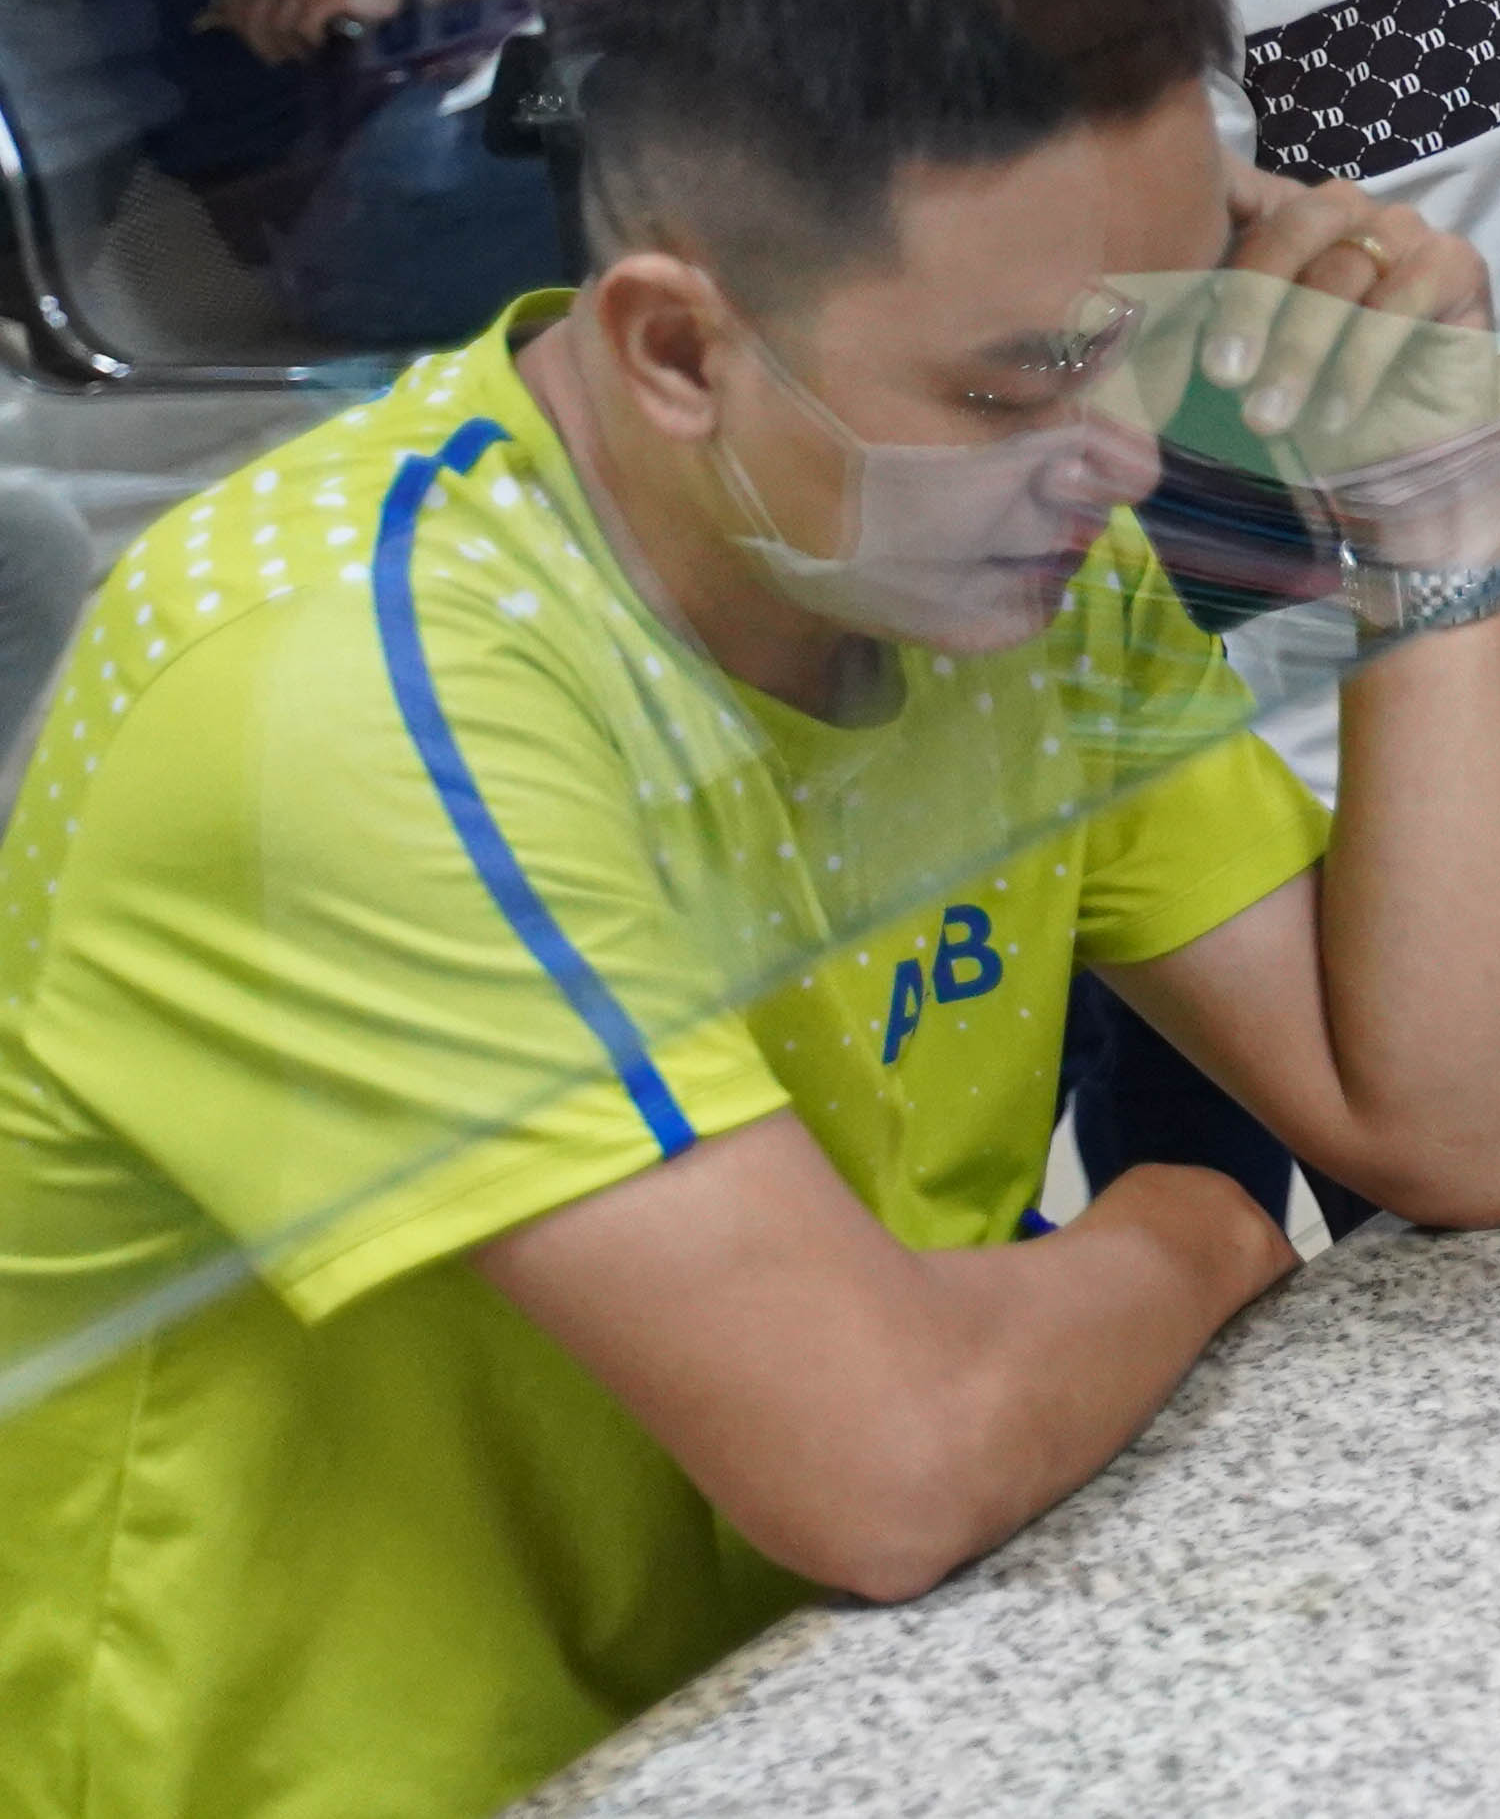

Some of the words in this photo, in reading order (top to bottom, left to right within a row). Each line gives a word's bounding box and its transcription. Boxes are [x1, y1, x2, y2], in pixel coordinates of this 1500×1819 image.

[1331, 7, 1359, 32] YD
[1372, 15, 1397, 40] YD
[1414, 28, 1445, 53] YD
[1466, 40, 1495, 66] YD
[1250, 41, 1282, 66] YD
[1299, 48, 1328, 72] YD
[1346, 61, 1370, 86] YD
[1388, 73, 1420, 99] YD
[1266, 95, 1295, 114] YD
[1440, 86, 1471, 112] YD
[1312, 107, 1344, 130] YD
[1361, 119, 1392, 145] YD
[1410, 131, 1443, 157] YD
[1277, 144, 1308, 166] YD
[882, 904, 1003, 1064] AB
